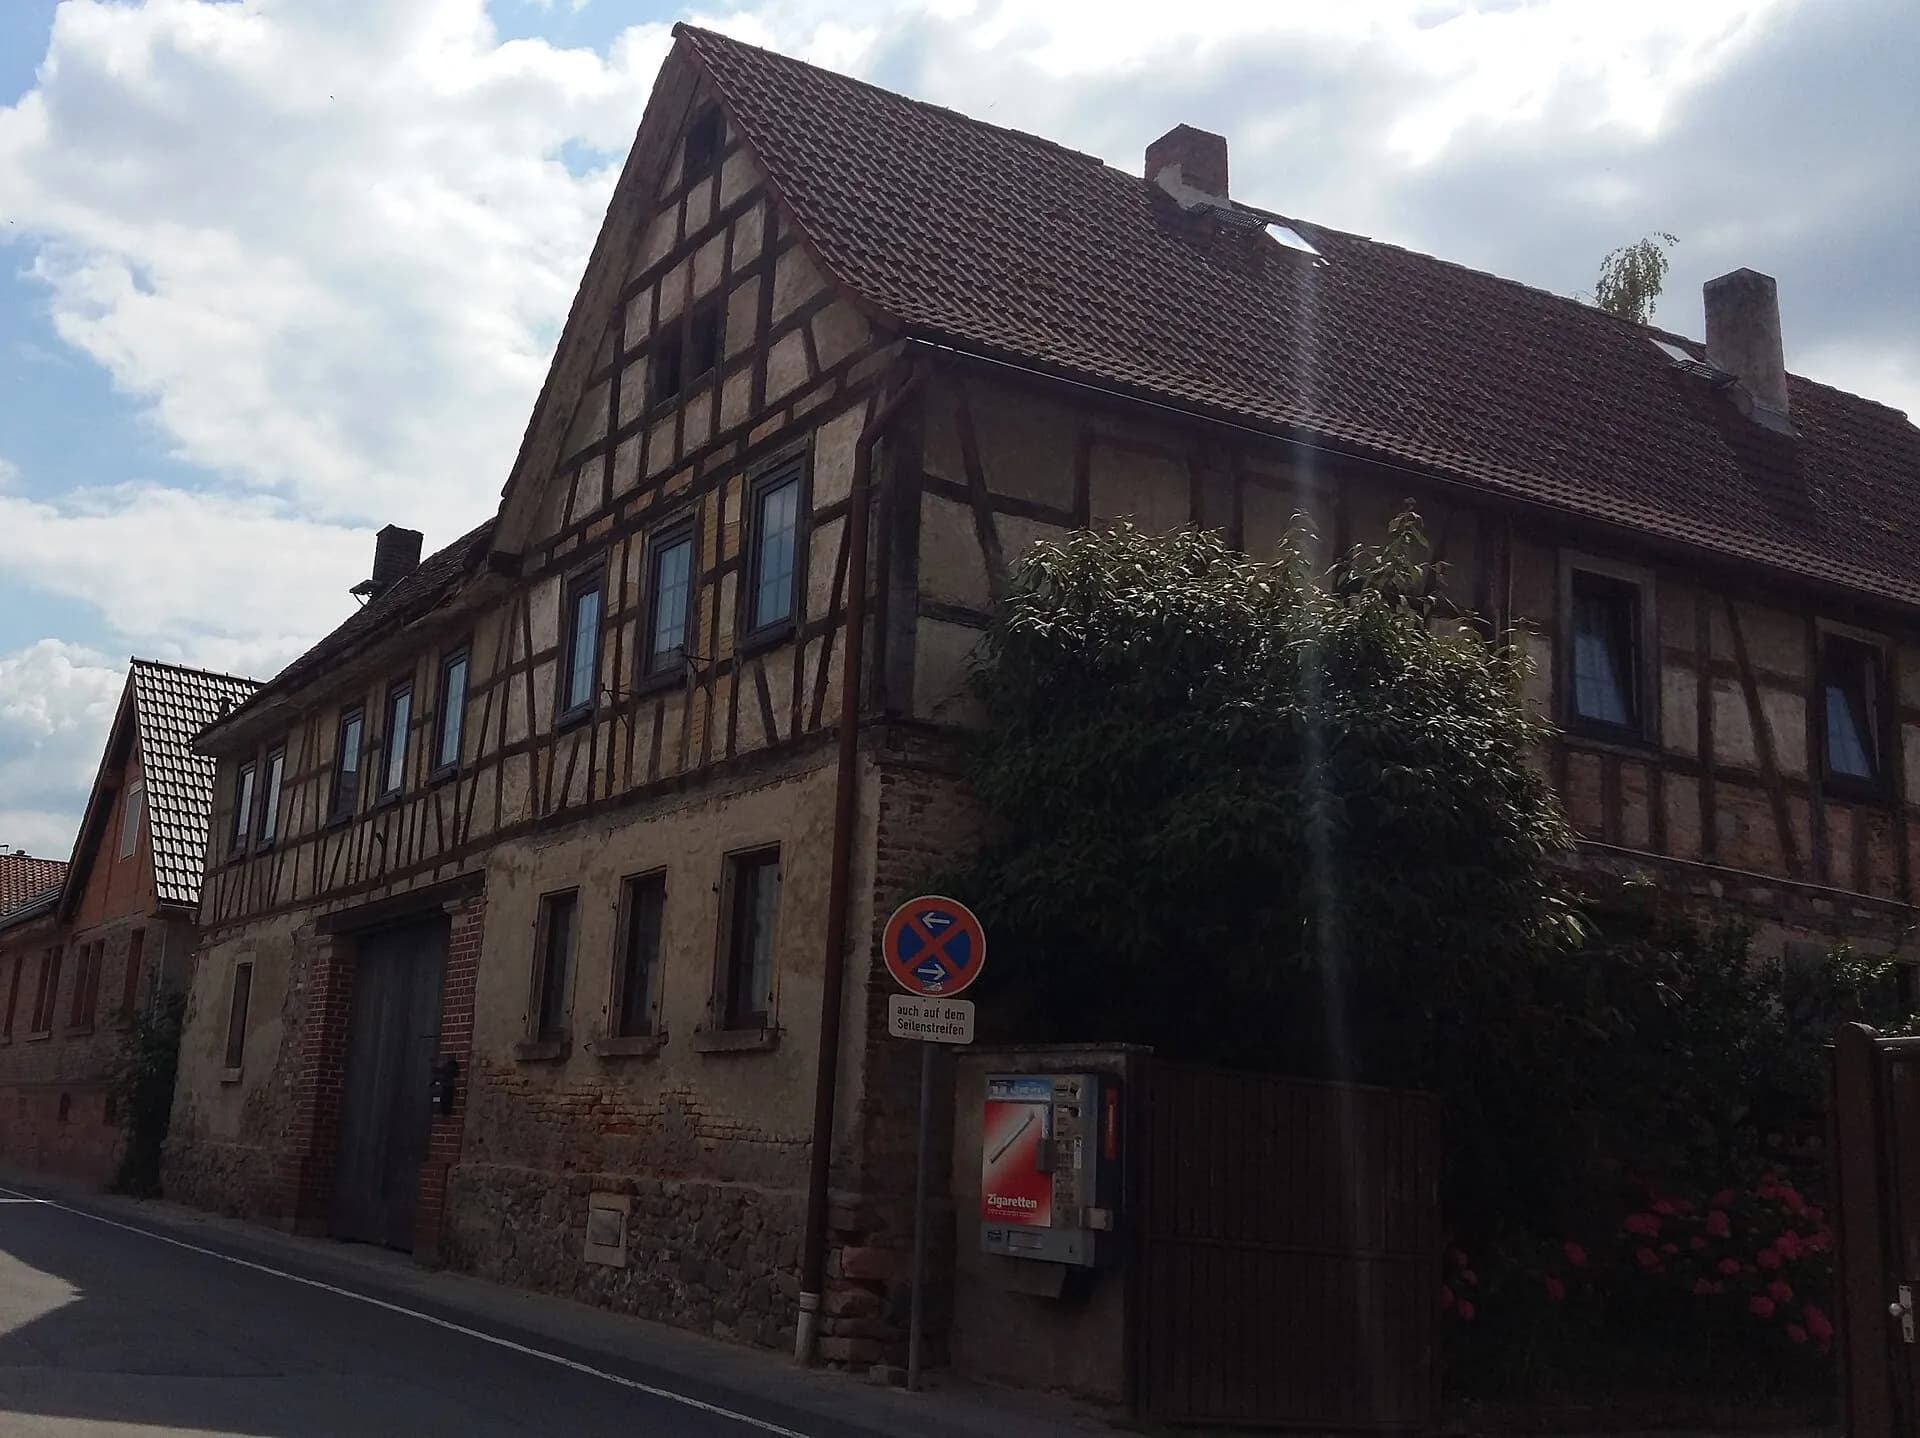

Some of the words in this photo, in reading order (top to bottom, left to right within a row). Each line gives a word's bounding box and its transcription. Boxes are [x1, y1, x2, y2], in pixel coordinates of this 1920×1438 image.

[897, 1005, 919, 1017] auch
[923, 1007, 941, 1018] auf
[944, 1008, 966, 1021] dem
[897, 1017, 965, 1036] Seitenstreifen
[987, 1193, 1038, 1209] Zigaretten
